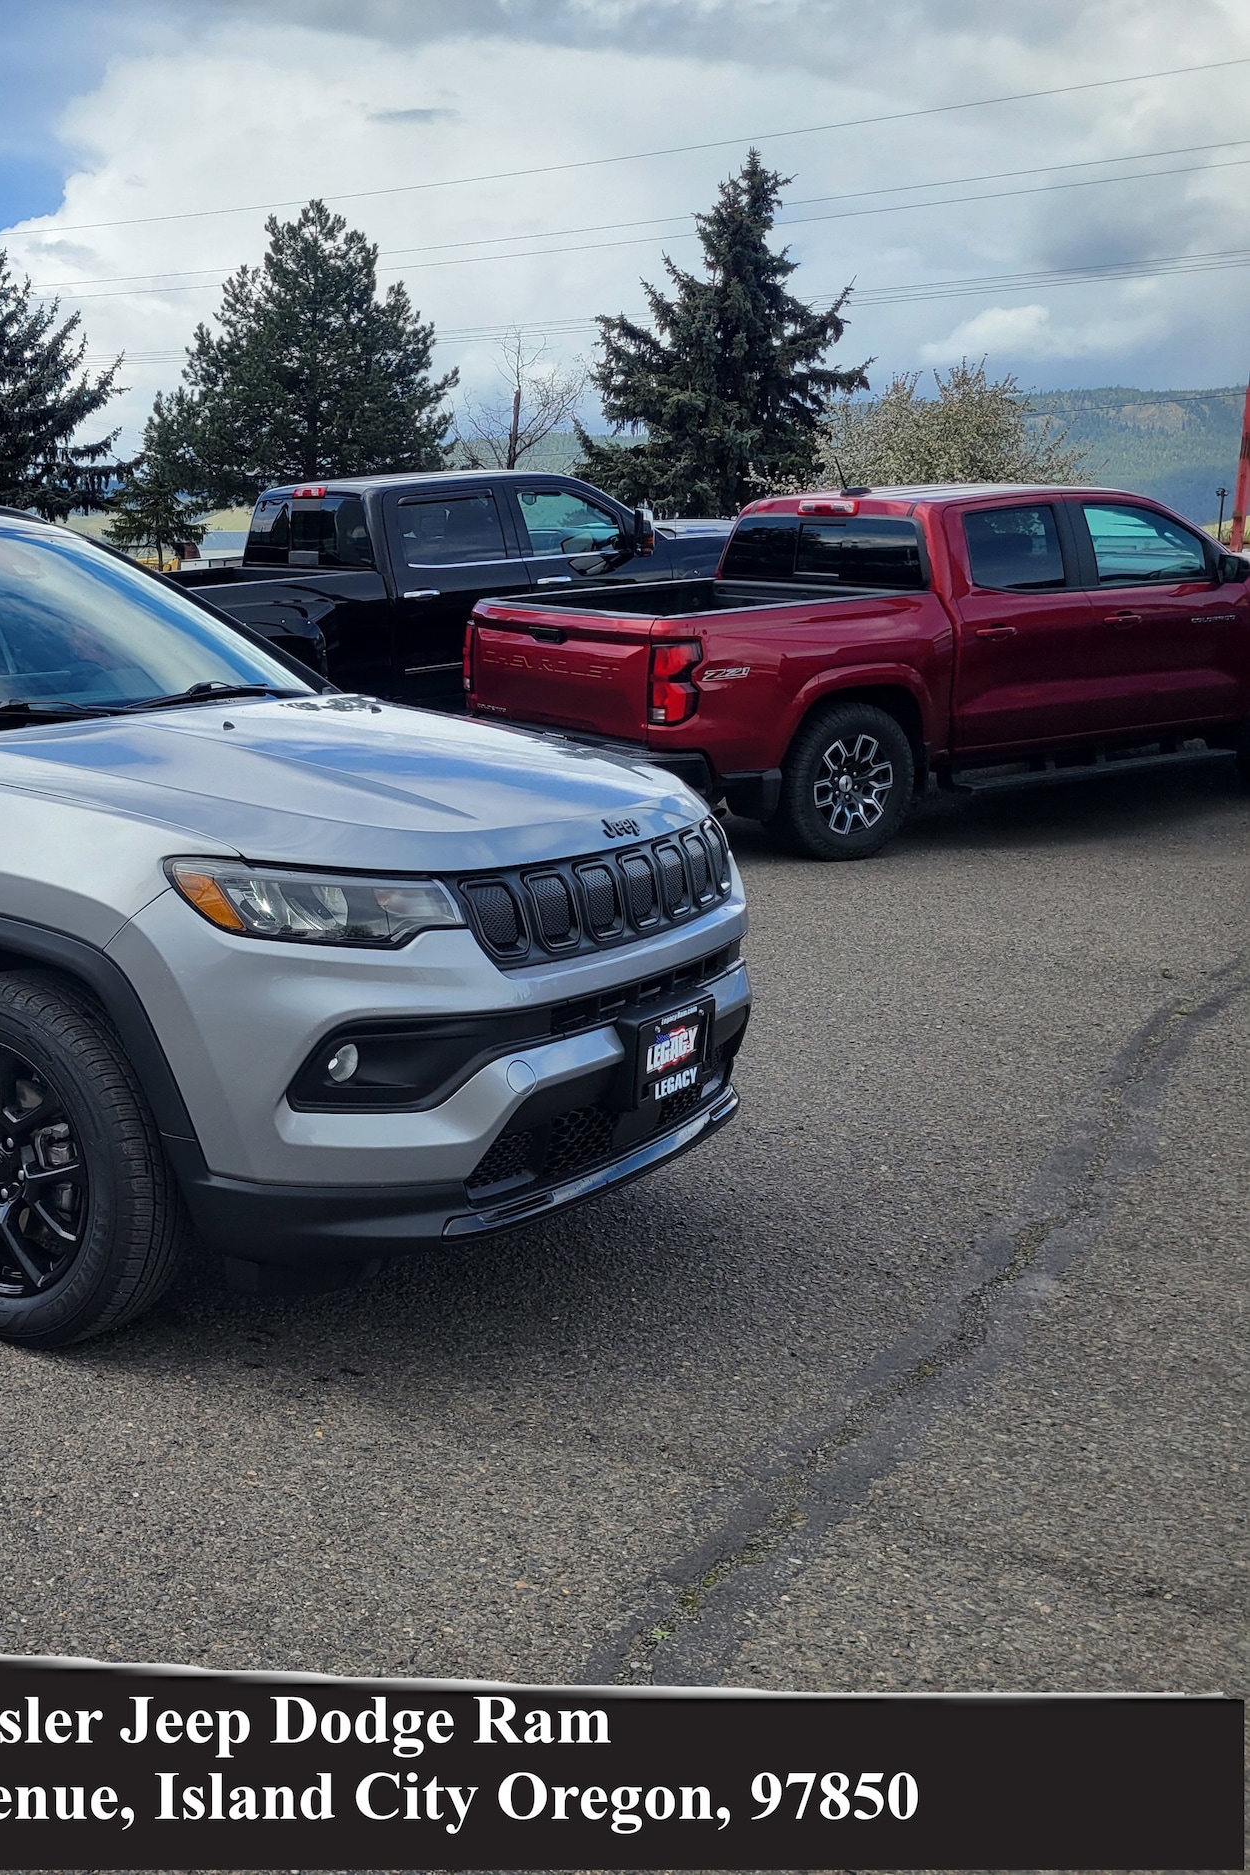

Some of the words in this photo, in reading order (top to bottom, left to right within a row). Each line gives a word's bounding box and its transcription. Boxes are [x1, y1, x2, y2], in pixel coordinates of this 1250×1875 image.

[601, 818, 641, 839] Jeep
[646, 1026, 699, 1074] LEGACY
[654, 1066, 698, 1101] LEGACY
